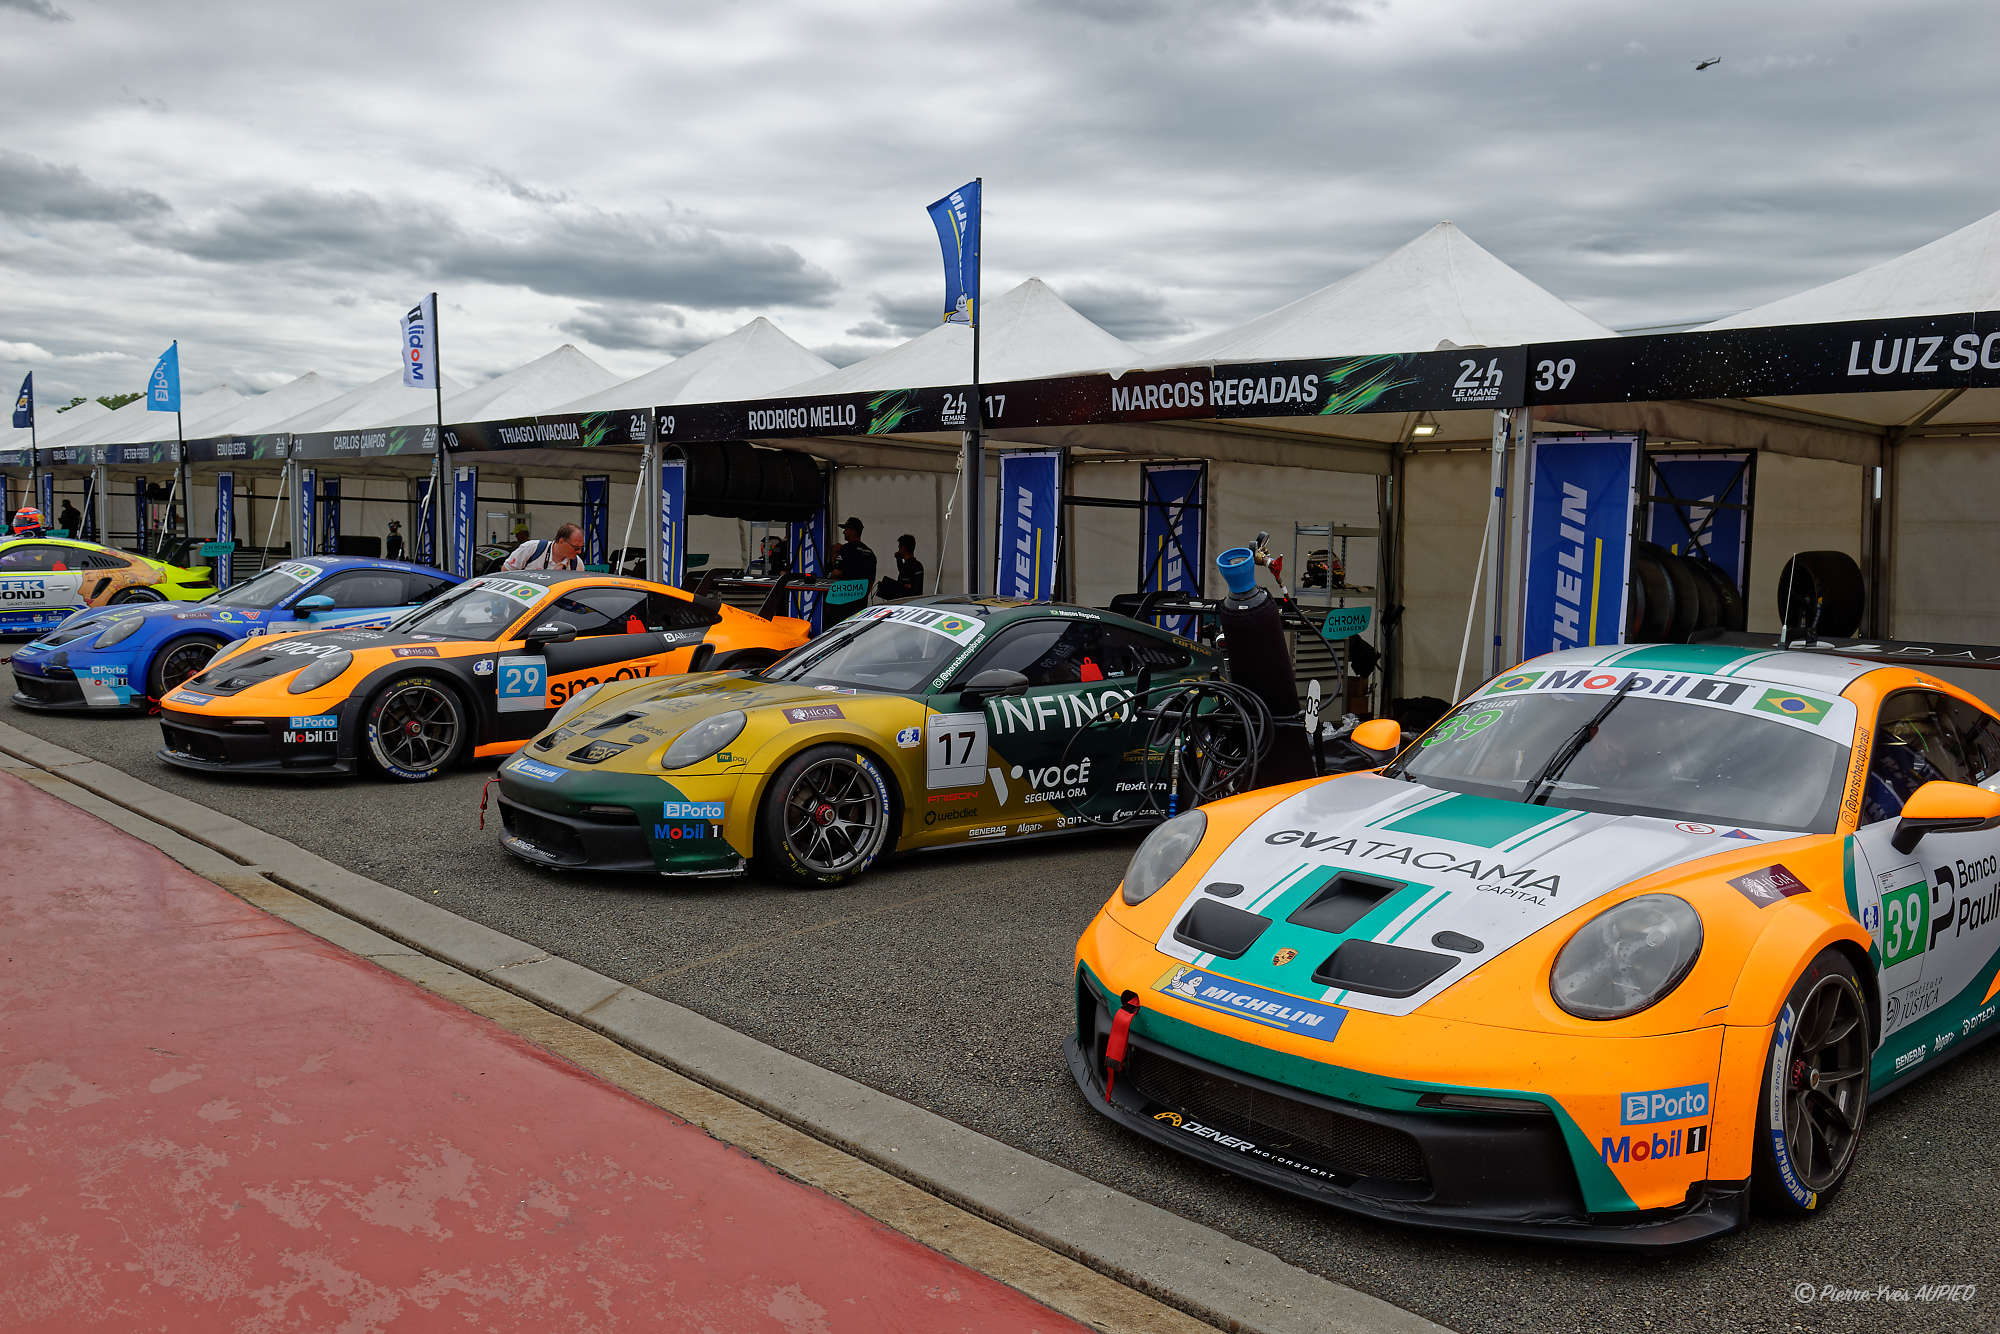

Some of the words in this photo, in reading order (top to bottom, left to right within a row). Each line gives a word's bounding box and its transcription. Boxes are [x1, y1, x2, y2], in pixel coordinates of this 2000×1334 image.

[1847, 335, 1944, 376] LUIZ
[1534, 358, 1576, 392] 39
[1111, 381, 1204, 412] MARCOS
[1210, 375, 1319, 406] REGADAS
[1452, 389, 1466, 397] LE
[1467, 387, 1500, 397] MANS
[748, 408, 808, 431] RODRIGO
[810, 404, 857, 427] MELLO
[985, 394, 1006, 418] 17
[499, 426, 534, 444] THIAGO
[534, 422, 580, 442] VIVACQUA
[661, 415, 675, 435] 29
[334, 435, 360, 450] CARLOS
[361, 433, 386, 449] CAMPOS
[444, 433, 458, 447] 10
[663, 489, 672, 585] HELIN
[1015, 486, 1033, 599] HELIN
[1553, 481, 1588, 651] HELIN
[0, 590, 45, 600] OND
[832, 584, 864, 593] CHROMA
[1328, 616, 1367, 626] CHROMA
[101, 665, 126, 674] Porto
[505, 667, 540, 694] 29
[1541, 670, 1690, 697] Mobil
[1476, 699, 1519, 710] Souza
[303, 716, 336, 728] Porto
[1421, 709, 1504, 749] 39
[284, 730, 323, 743] Mobil
[938, 731, 976, 766] 17
[522, 763, 558, 778] MICHELIN
[1027, 757, 1091, 790] VOCÊ
[1845, 727, 1871, 814] @porschecupbrasil
[867, 766, 889, 811] MICHELIN
[681, 803, 722, 817] Porto
[655, 823, 704, 840] Mobil
[968, 825, 1007, 837] GENERAC
[1956, 854, 1997, 889] Banco
[1476, 883, 1548, 907] CAPITAL
[1886, 892, 1922, 959] 39
[1199, 984, 1326, 1028] MICHELIN
[1895, 1044, 1927, 1070] GENERAC
[1774, 1056, 1783, 1093] SPORT
[1650, 1088, 1706, 1120] Porto
[1773, 1094, 1782, 1122] PILOT
[1180, 1120, 1255, 1153] DENER
[1253, 1148, 1336, 1180] MOTORSPORT
[1601, 1128, 1682, 1164] Mobil
[1774, 1136, 1806, 1204] MICHELIN
